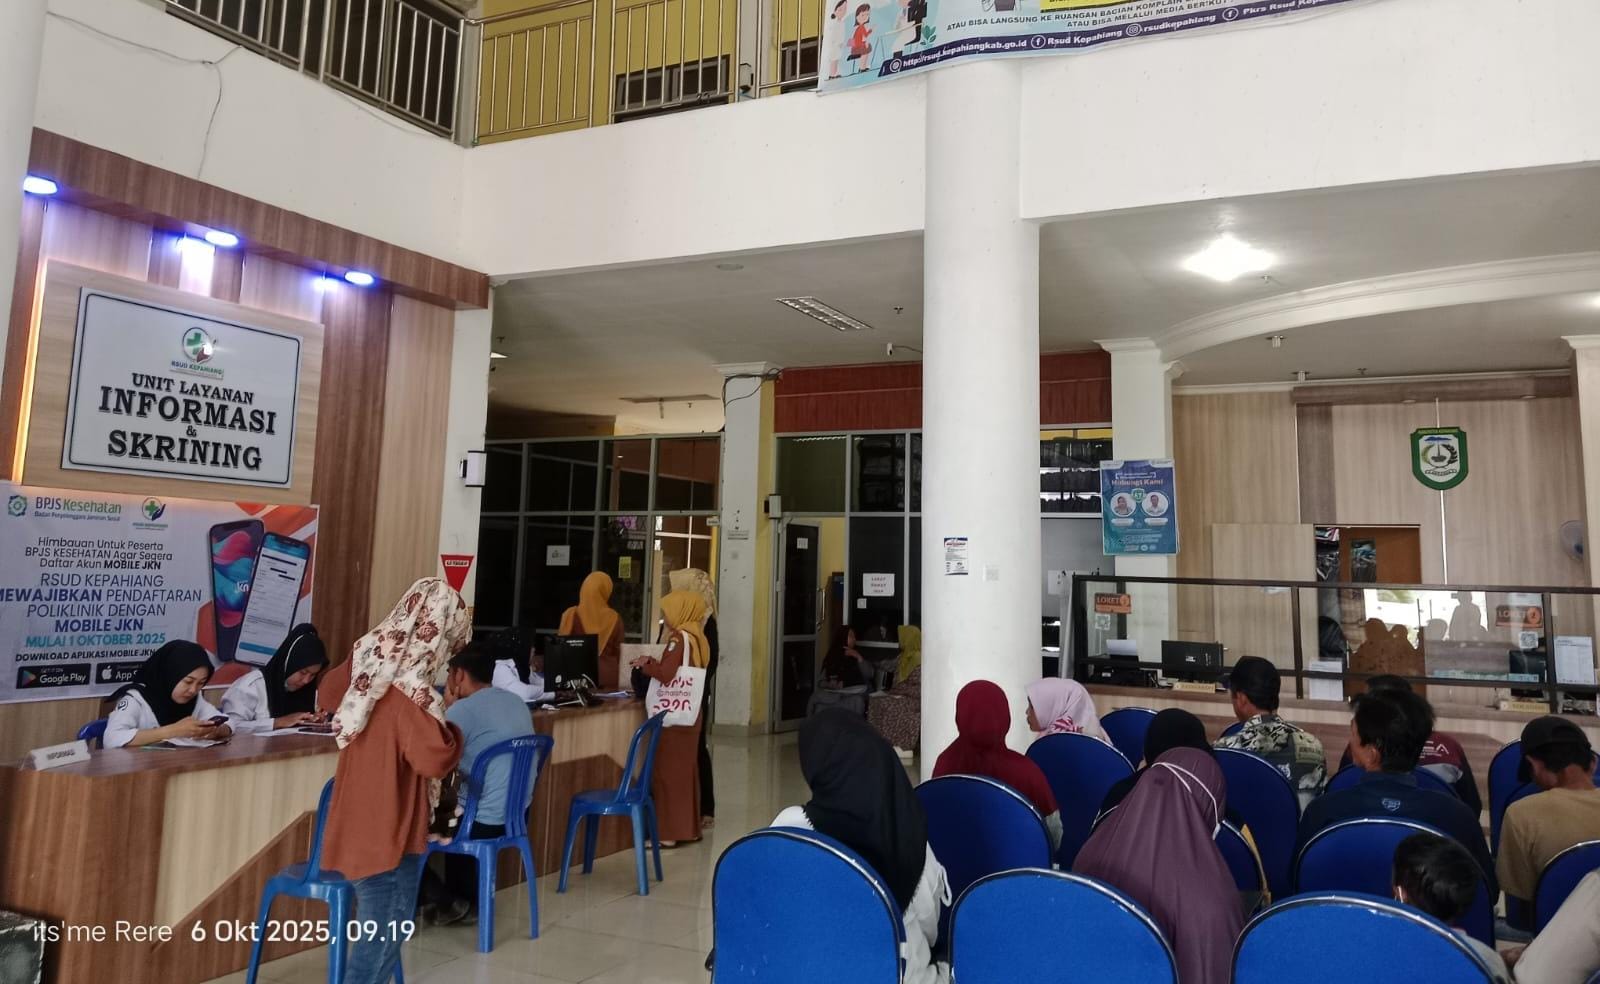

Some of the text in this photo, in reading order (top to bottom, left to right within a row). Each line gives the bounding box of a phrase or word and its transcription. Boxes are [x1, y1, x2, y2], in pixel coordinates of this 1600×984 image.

[969, 17, 988, 26] BISA
[990, 15, 1038, 25] LANGSUNG
[1055, 11, 1097, 20] RUANGAN
[1100, 6, 1133, 17] BAGIAN
[1115, 11, 1153, 21] MELALUI
[1156, 5, 1184, 16] MEDIA
[1047, 36, 1071, 46] Rsud
[1073, 30, 1122, 44] Kepahiang
[1143, 14, 1216, 33] rsudkepahiang
[1269, 1, 1296, 10] Rsud
[132, 372, 254, 405] UNIT LAYANAN
[98, 386, 276, 435] INFORMASI
[186, 425, 197, 438] &
[107, 429, 262, 471] SKRINING
[35, 496, 122, 514] BPJS Kesehatan
[38, 537, 163, 551] Himbauan Untuk Peserta
[25, 546, 173, 561] BPJS KESEHATAN Agar Segera
[40, 558, 161, 570] Daftar Akun MOBILE JKN
[40, 573, 164, 587] RSUD KEPAHIANG
[106, 589, 202, 601] PENDAFTARAN
[27, 604, 166, 618] POLIKLINIK DENGAN
[54, 618, 144, 632] MOBILE JKN
[26, 633, 166, 648] MULAI 1 OKTOBER 2025
[15, 651, 69, 662] DOWNLOAD
[70, 651, 108, 660] APLIKASI
[109, 650, 139, 659] MOBILE
[40, 673, 86, 685] Google Play
[115, 671, 132, 680] App
